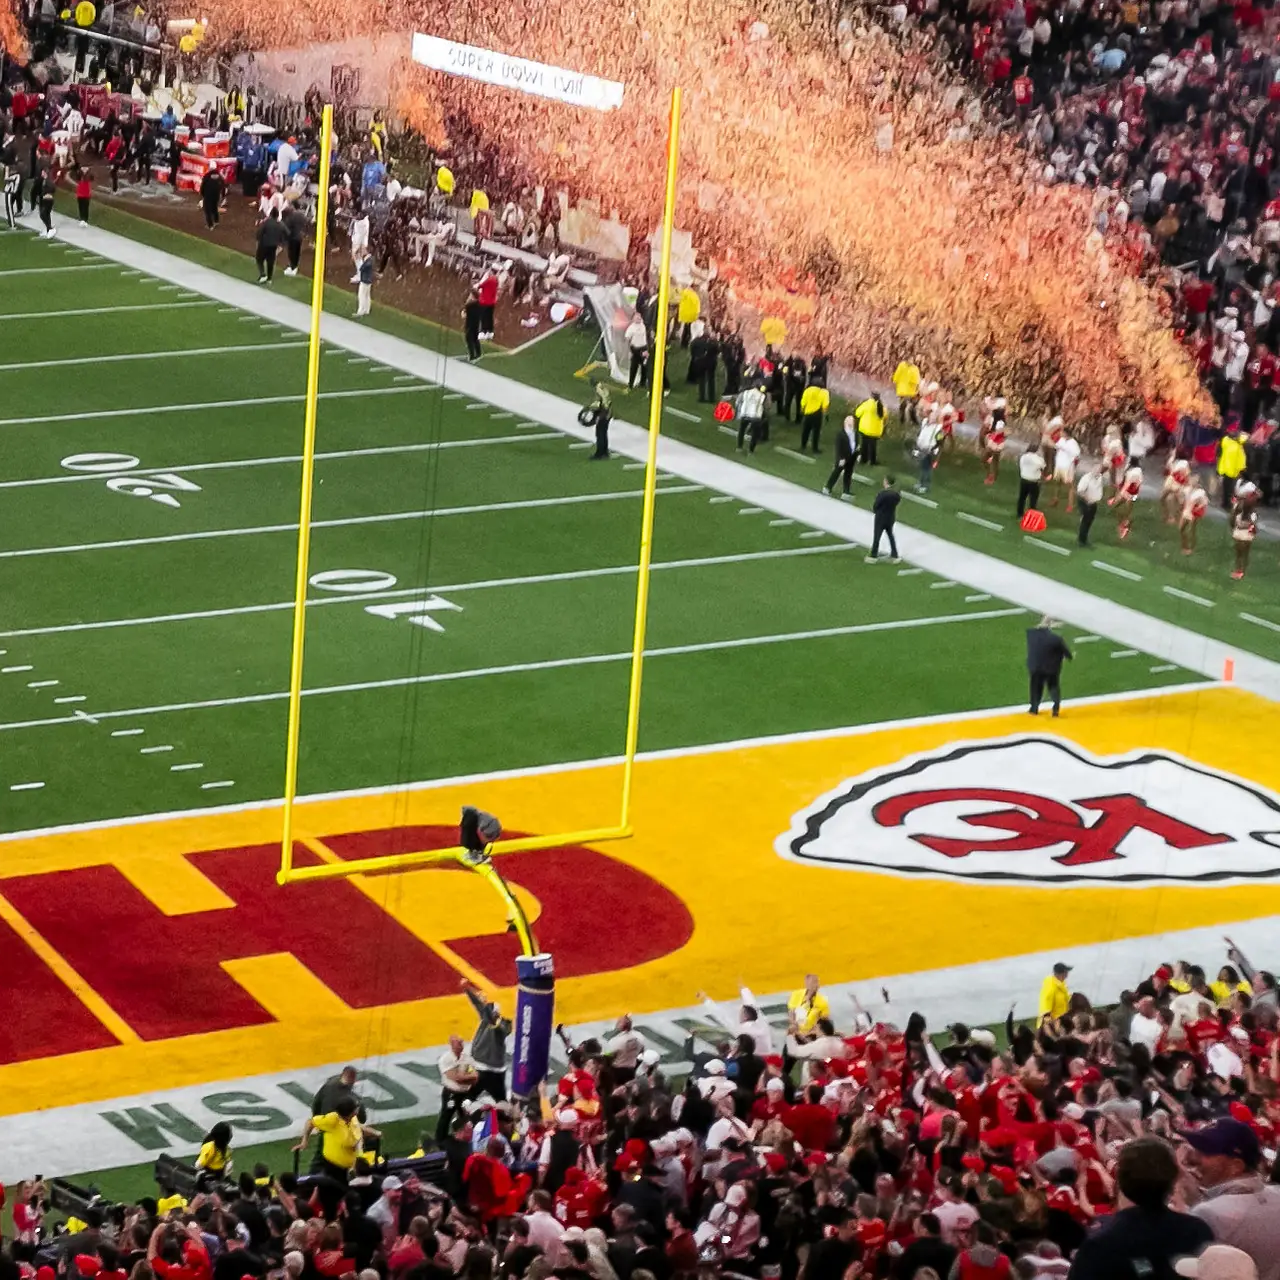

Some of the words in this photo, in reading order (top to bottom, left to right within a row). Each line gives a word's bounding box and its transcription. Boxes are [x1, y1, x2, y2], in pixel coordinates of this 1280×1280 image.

[60, 452, 203, 497] 20
[309, 569, 464, 620] 10
[98, 1056, 445, 1152] ACISM
